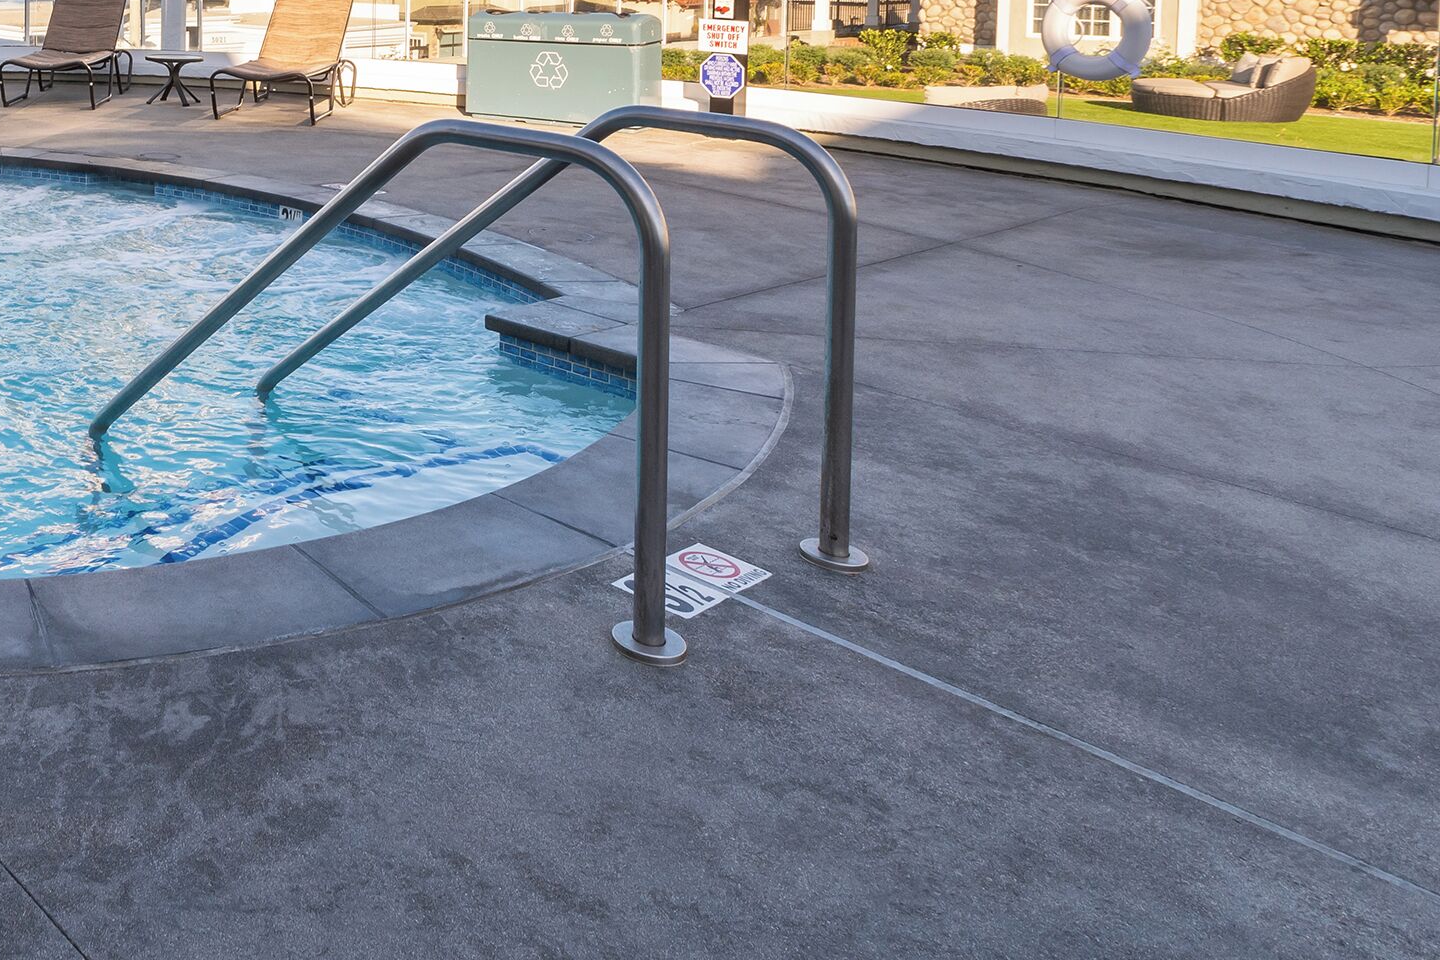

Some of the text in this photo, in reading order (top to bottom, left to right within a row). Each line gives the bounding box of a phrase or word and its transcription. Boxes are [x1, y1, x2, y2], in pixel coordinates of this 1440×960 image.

[702, 24, 745, 33] EMERGENCY
[707, 32, 740, 41] SHUT OFF
[709, 40, 738, 49] SWITCH
[720, 568, 767, 591] NO DIVING
